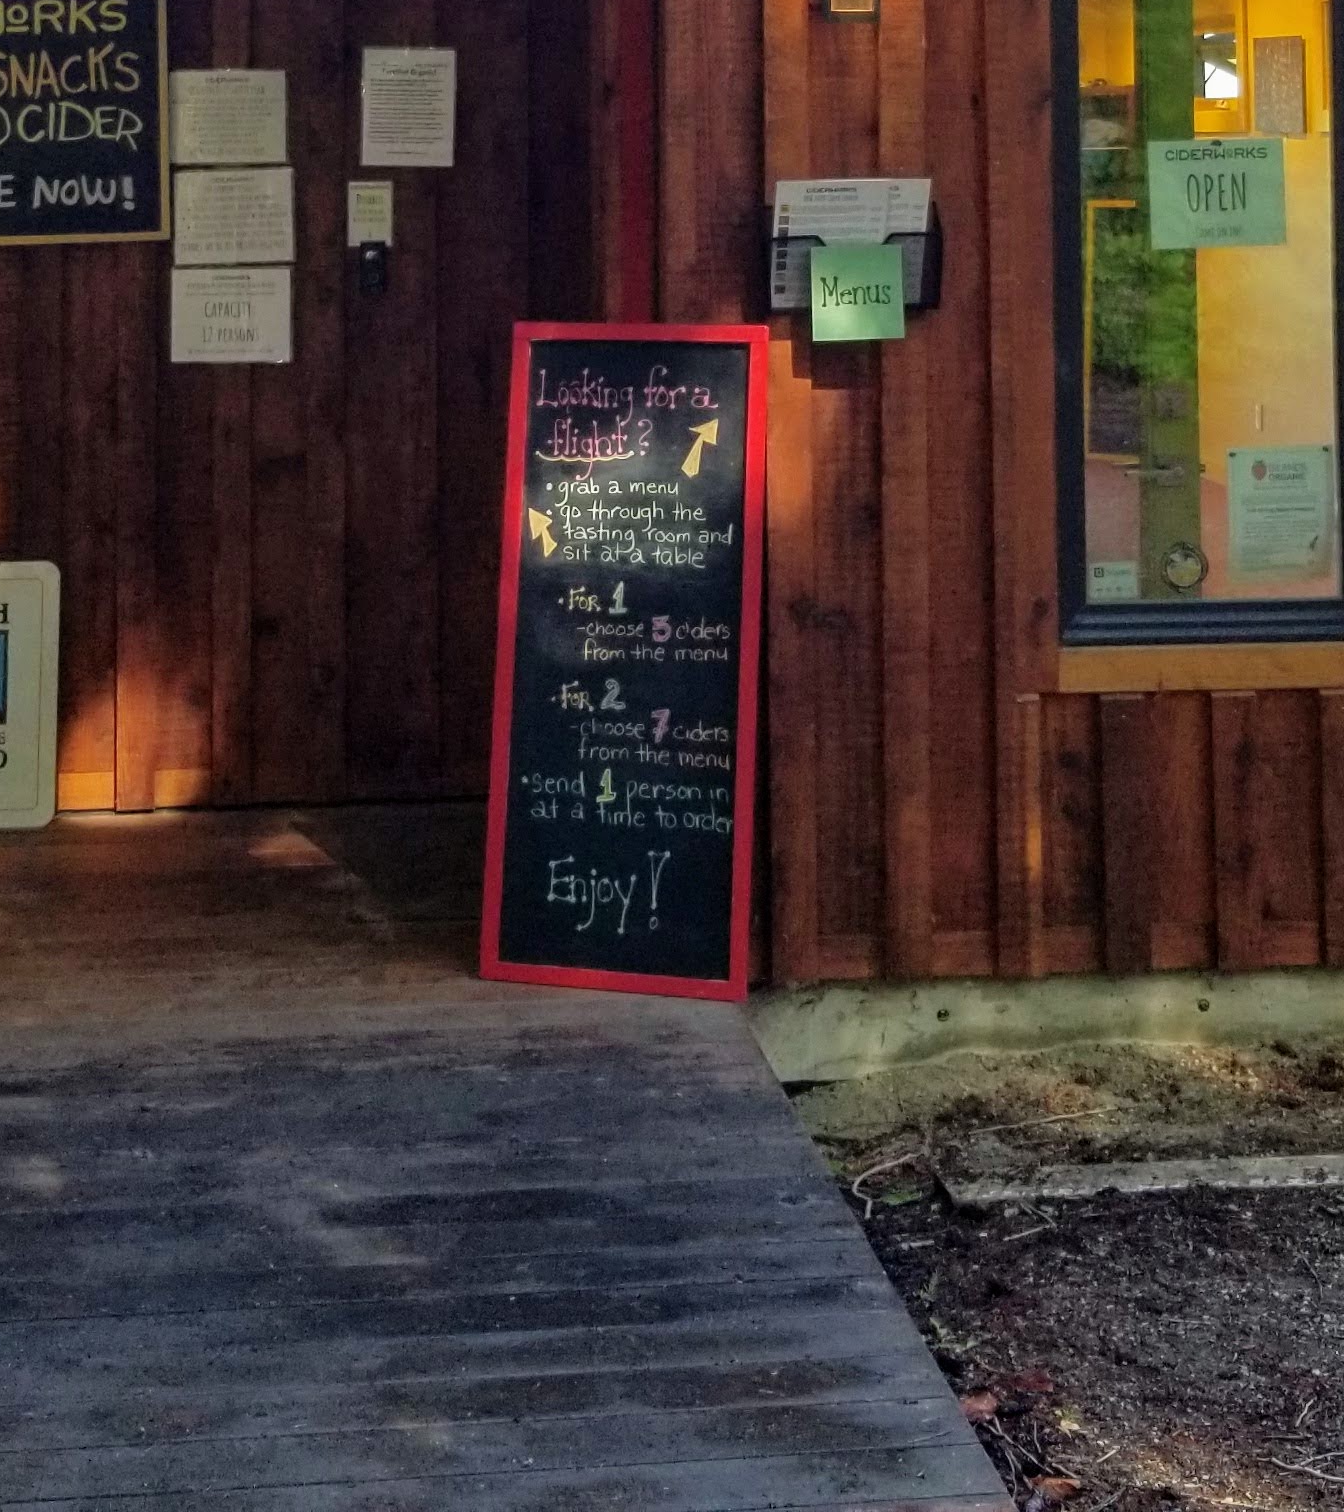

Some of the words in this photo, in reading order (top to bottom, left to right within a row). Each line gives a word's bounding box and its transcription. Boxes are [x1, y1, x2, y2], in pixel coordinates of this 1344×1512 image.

[17, 101, 144, 152] CIDER
[32, 174, 136, 212] NOW!
[1187, 172, 1247, 213] OPEN
[820, 275, 891, 307] Menus
[536, 368, 634, 426] Looking
[644, 365, 686, 409] for
[691, 387, 719, 408] a
[555, 477, 600, 507] grab
[608, 480, 623, 494] a
[629, 481, 679, 495] menu
[560, 503, 581, 528] go
[587, 499, 664, 531] through
[672, 502, 706, 521] the
[563, 522, 634, 553] tasting
[646, 528, 690, 543] room
[698, 523, 733, 545] and
[563, 543, 591, 561] sit
[601, 542, 624, 563] at
[630, 548, 646, 563] a
[651, 544, 705, 568] table
[608, 581, 628, 614] 1
[652, 615, 672, 642] 5
[676, 616, 731, 639] ciders
[582, 638, 625, 661] from
[630, 644, 665, 661] the
[675, 646, 728, 661] menu
[600, 679, 626, 710] 2
[651, 708, 671, 743] 7
[672, 719, 729, 741] ciders
[578, 737, 629, 760] from
[635, 743, 670, 766] the
[678, 750, 730, 770] menu
[596, 768, 616, 802] 1
[626, 780, 701, 813] person
[710, 787, 729, 802] in
[531, 798, 558, 819] at
[571, 802, 584, 819] a
[596, 802, 645, 827] time
[656, 805, 677, 827] to
[683, 805, 733, 833] order
